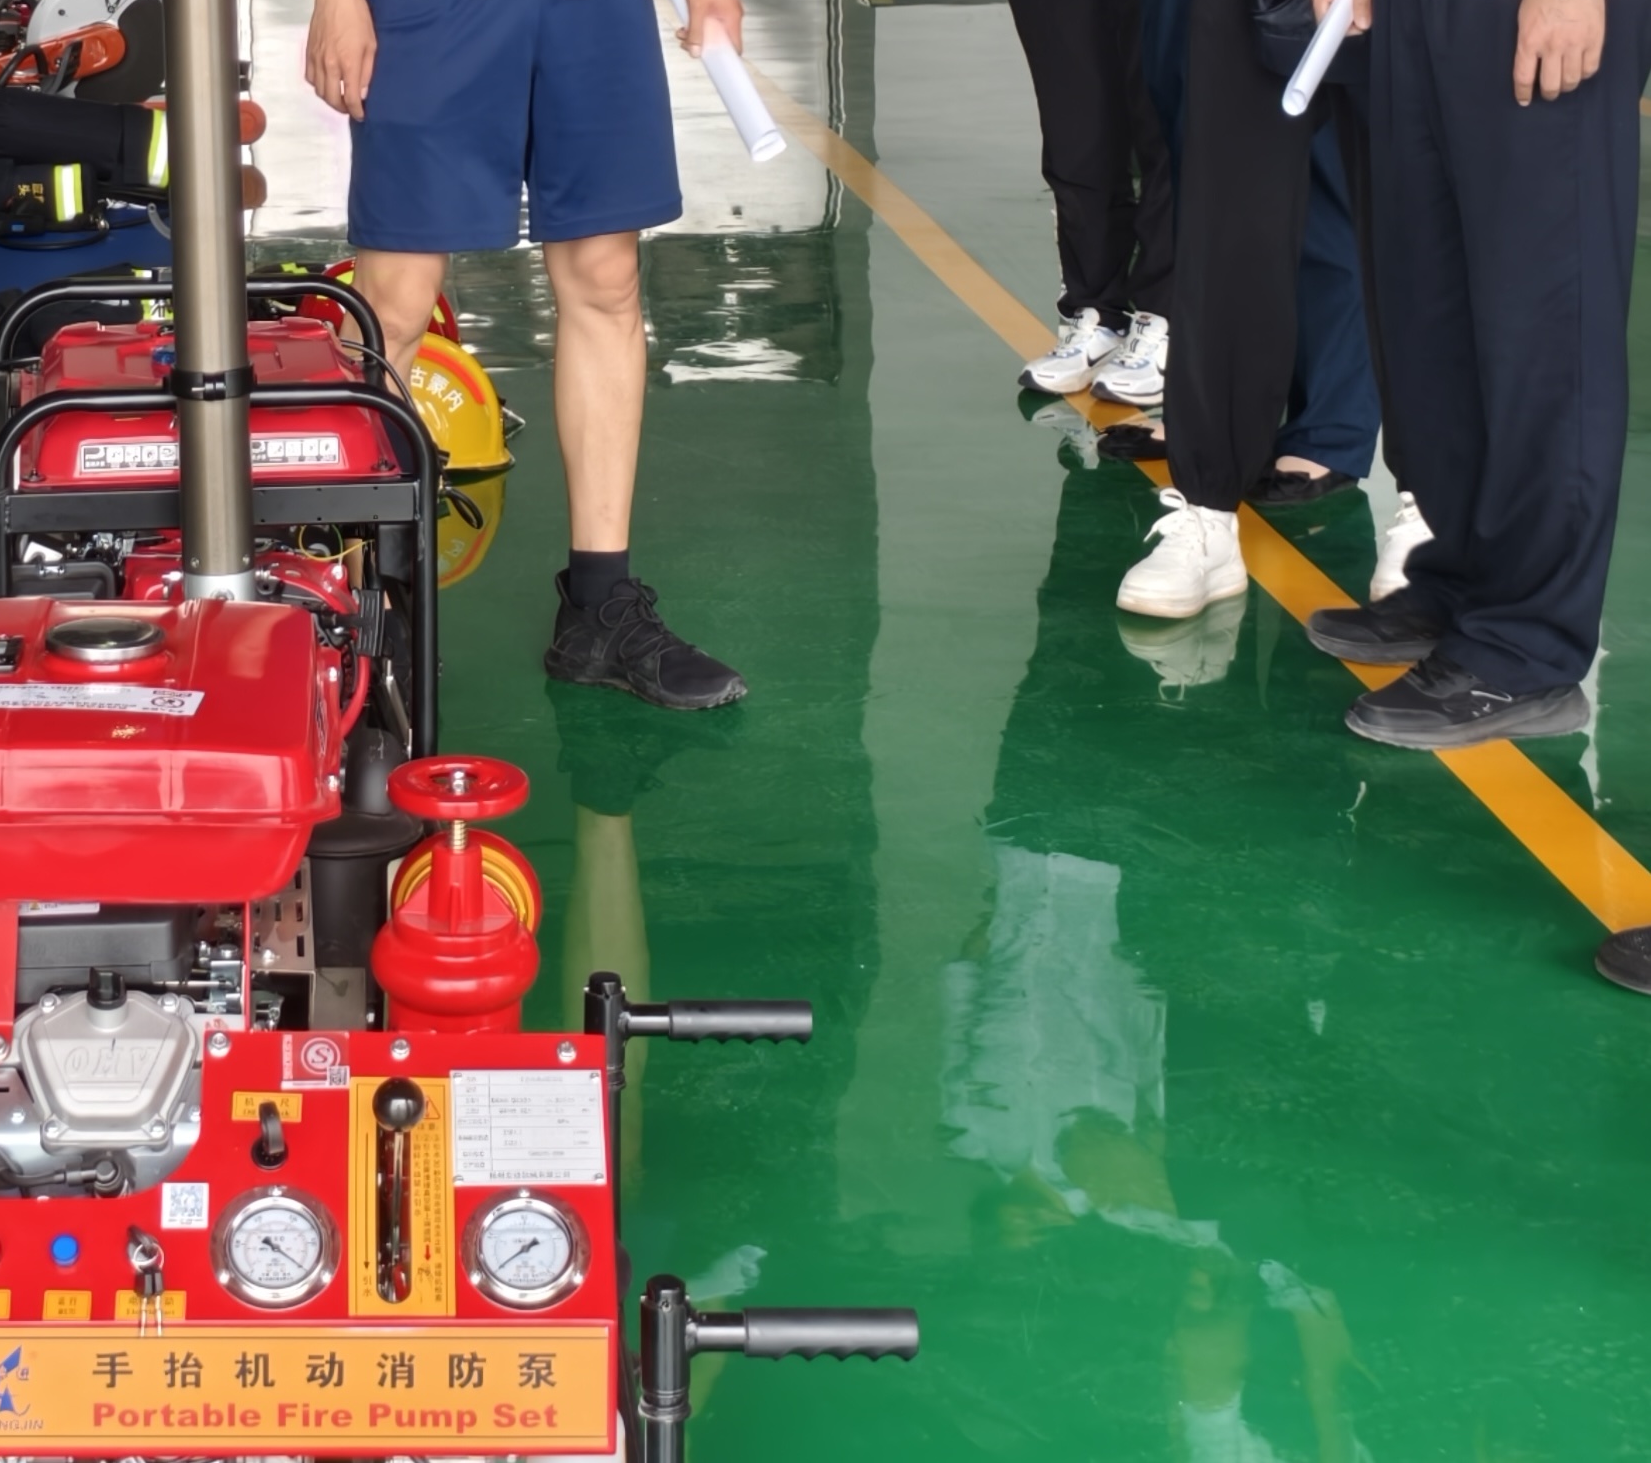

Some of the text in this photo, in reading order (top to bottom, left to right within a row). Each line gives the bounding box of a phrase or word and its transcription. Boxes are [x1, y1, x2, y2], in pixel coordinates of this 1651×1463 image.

[92, 1351, 558, 1389] 手抬机动消防泵
[92, 1402, 559, 1435] Portable Fire Pump Set
